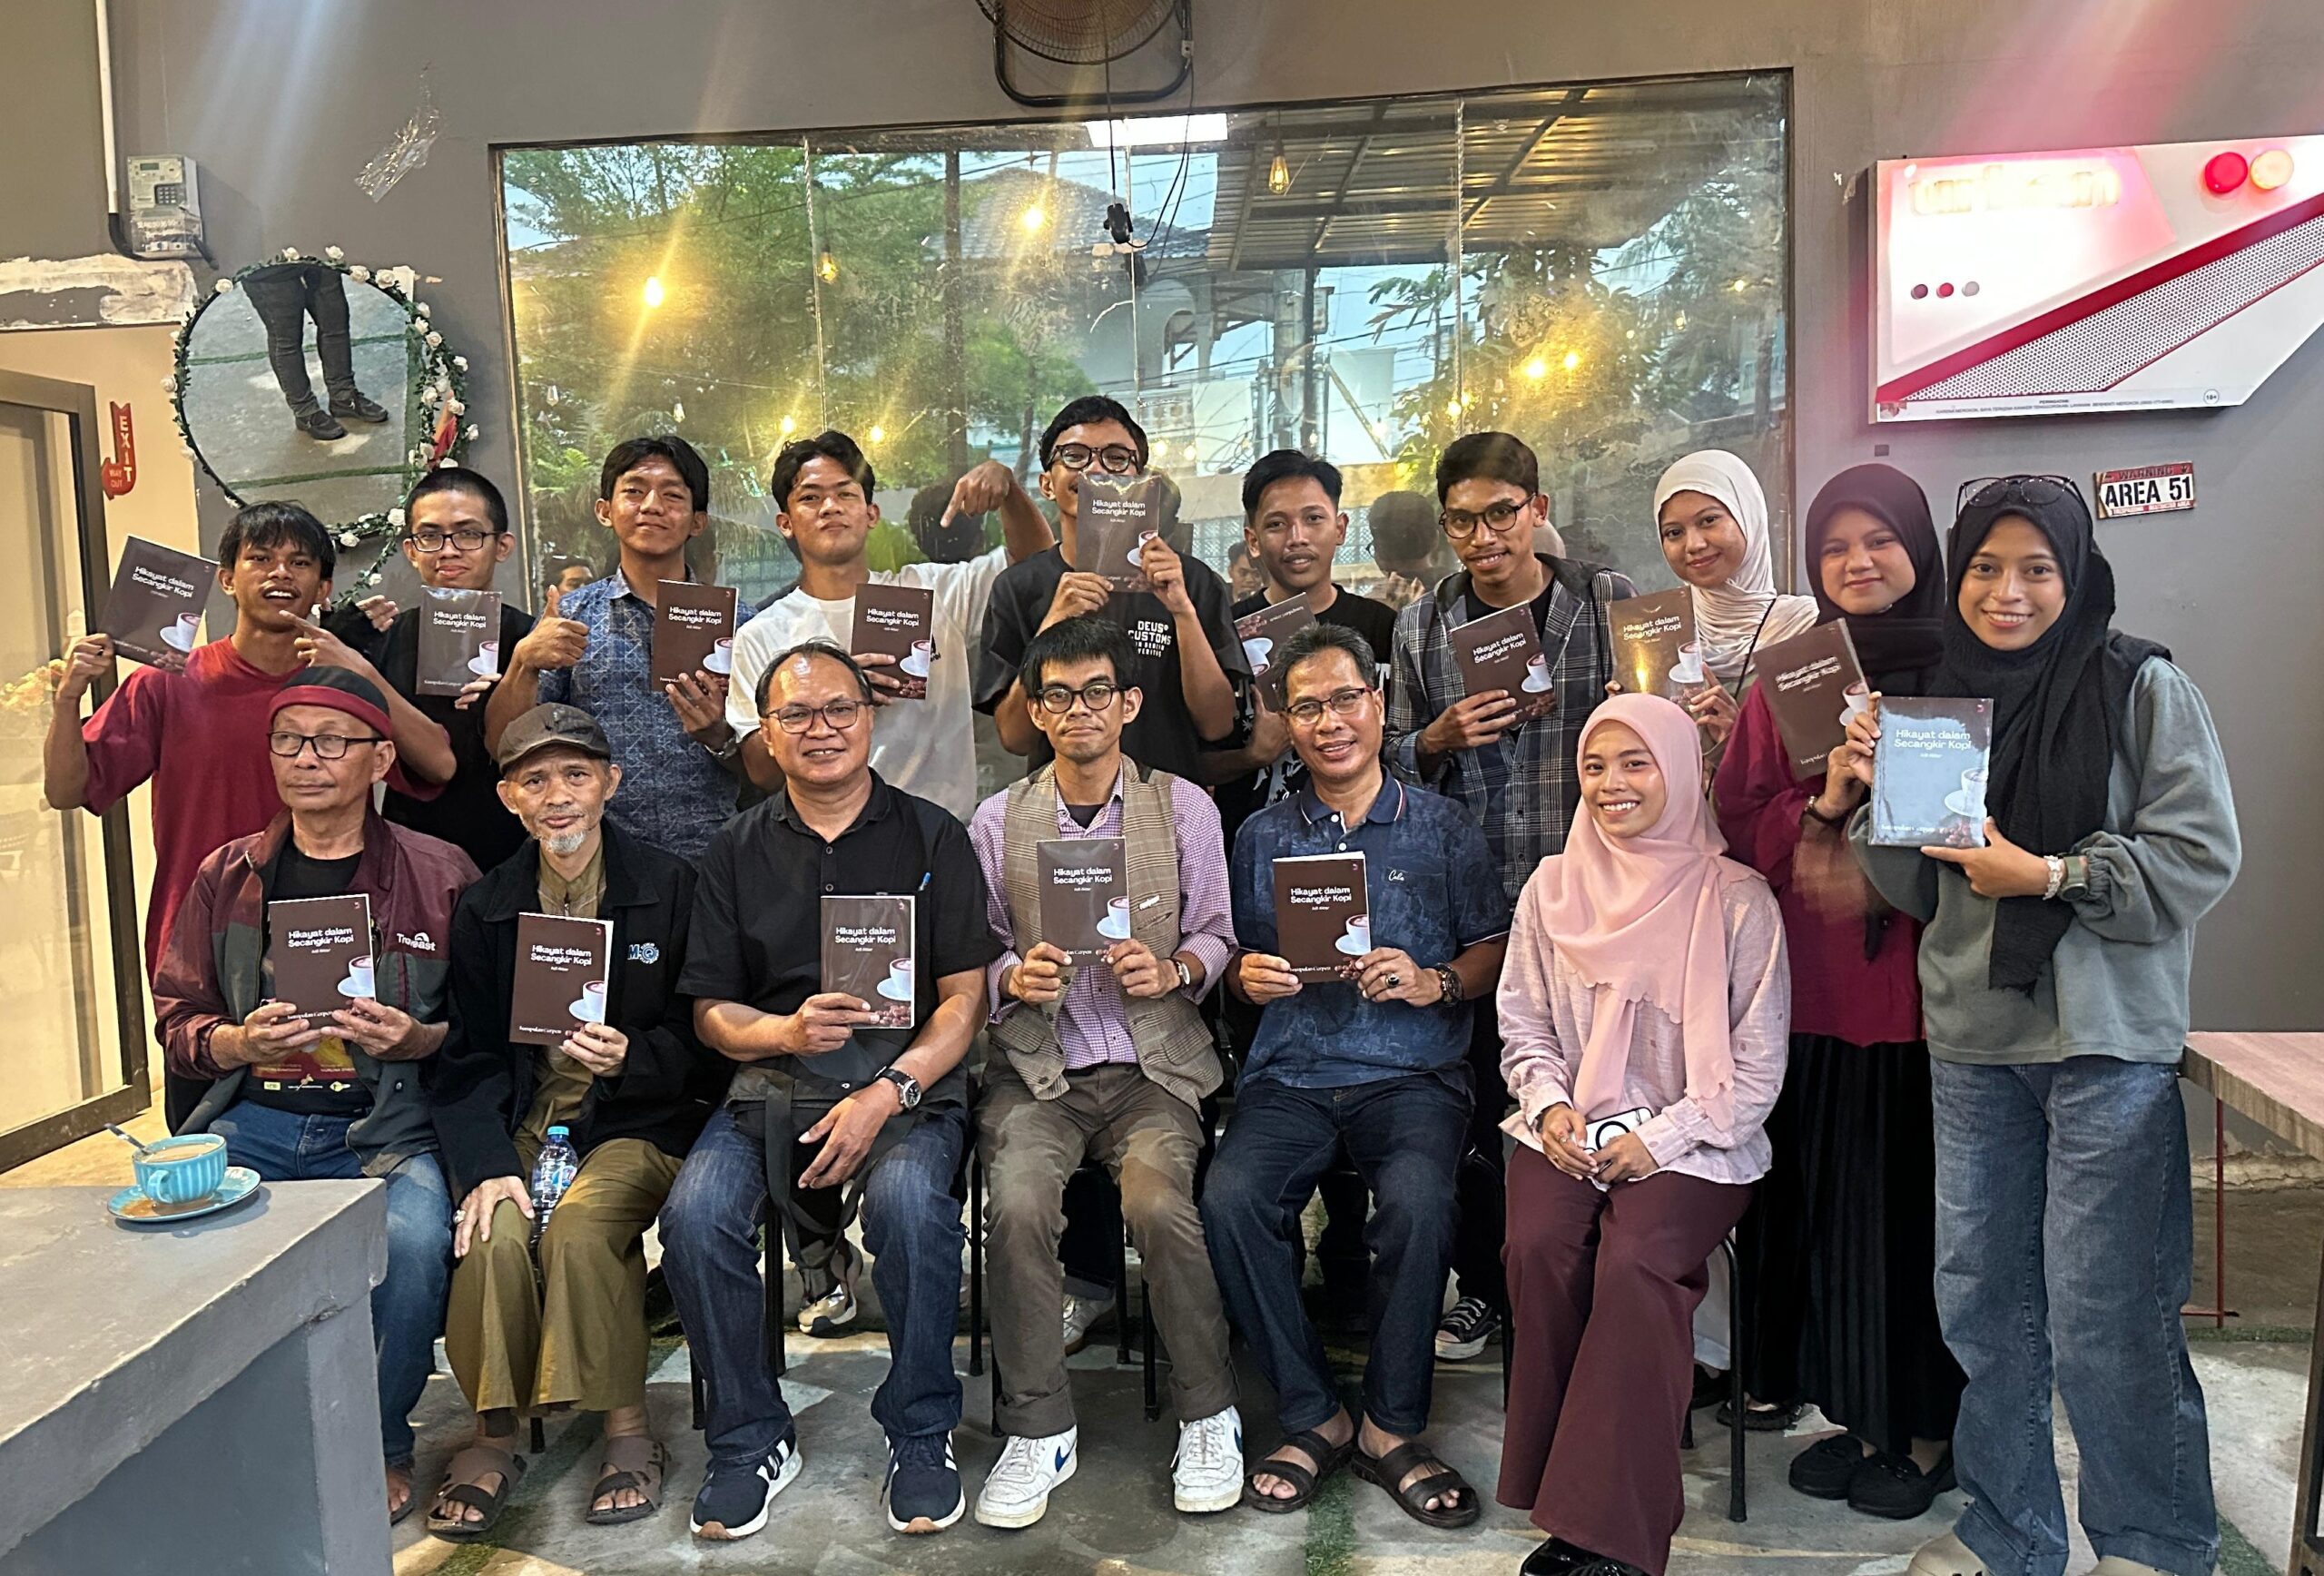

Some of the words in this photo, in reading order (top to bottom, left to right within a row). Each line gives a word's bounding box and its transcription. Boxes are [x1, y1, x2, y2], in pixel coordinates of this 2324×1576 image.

[119, 416, 133, 482] EXIT
[2120, 466, 2174, 480] WARNING
[110, 479, 123, 488] OUT
[2105, 480, 2162, 507] AREA
[2169, 477, 2191, 501] 51
[1092, 499, 1121, 509] Hikayat
[1091, 507, 1128, 517] Secangkir
[1129, 508, 1146, 517] Kopi
[134, 566, 167, 581] Hikayat
[168, 575, 194, 591] dalam
[132, 573, 173, 591] Secangkir
[173, 586, 193, 598] Kopi
[434, 611, 461, 620] Hikayat
[669, 606, 697, 616] Hikayat
[699, 609, 722, 617] dalam
[867, 608, 895, 617] Hikayat
[470, 621, 487, 629] Kopi
[668, 614, 704, 624] Secangkir
[705, 617, 722, 625] Kopi
[866, 616, 902, 625] Secangkir
[902, 618, 919, 627] Kopi
[1137, 620, 1165, 634] DEUS
[1472, 641, 1501, 655] Hikayat
[1501, 633, 1524, 645] dalam
[1474, 645, 1509, 664] Secangkir
[1510, 638, 1527, 649] Kopi
[1896, 729, 1936, 741] Hikayat
[1937, 731, 1971, 740] dalam
[1894, 739, 1945, 750] Secangkir
[1948, 740, 1972, 751] Kopi
[1053, 868, 1085, 878] Hikayat
[1086, 867, 1112, 875] dalam
[1053, 875, 1093, 885] Secangkir
[1094, 874, 1113, 883] Kopi
[1290, 888, 1323, 897] Hikayat
[1324, 886, 1351, 895] dalam
[1290, 895, 1331, 904] Secangkir
[1333, 894, 1352, 903] Kopi
[288, 930, 323, 941] Hikayat
[324, 927, 353, 936] dalam
[835, 927, 867, 937] Hikayat
[869, 927, 896, 935] dalam
[288, 938, 331, 949] Secangkir
[333, 935, 354, 944] Kopi
[835, 935, 876, 945] Secangkir
[877, 935, 896, 945] Kopi
[531, 944, 564, 955] Hikayat
[565, 947, 592, 957] dalam
[530, 953, 572, 964] Secangkir
[573, 957, 593, 967] Kopi
